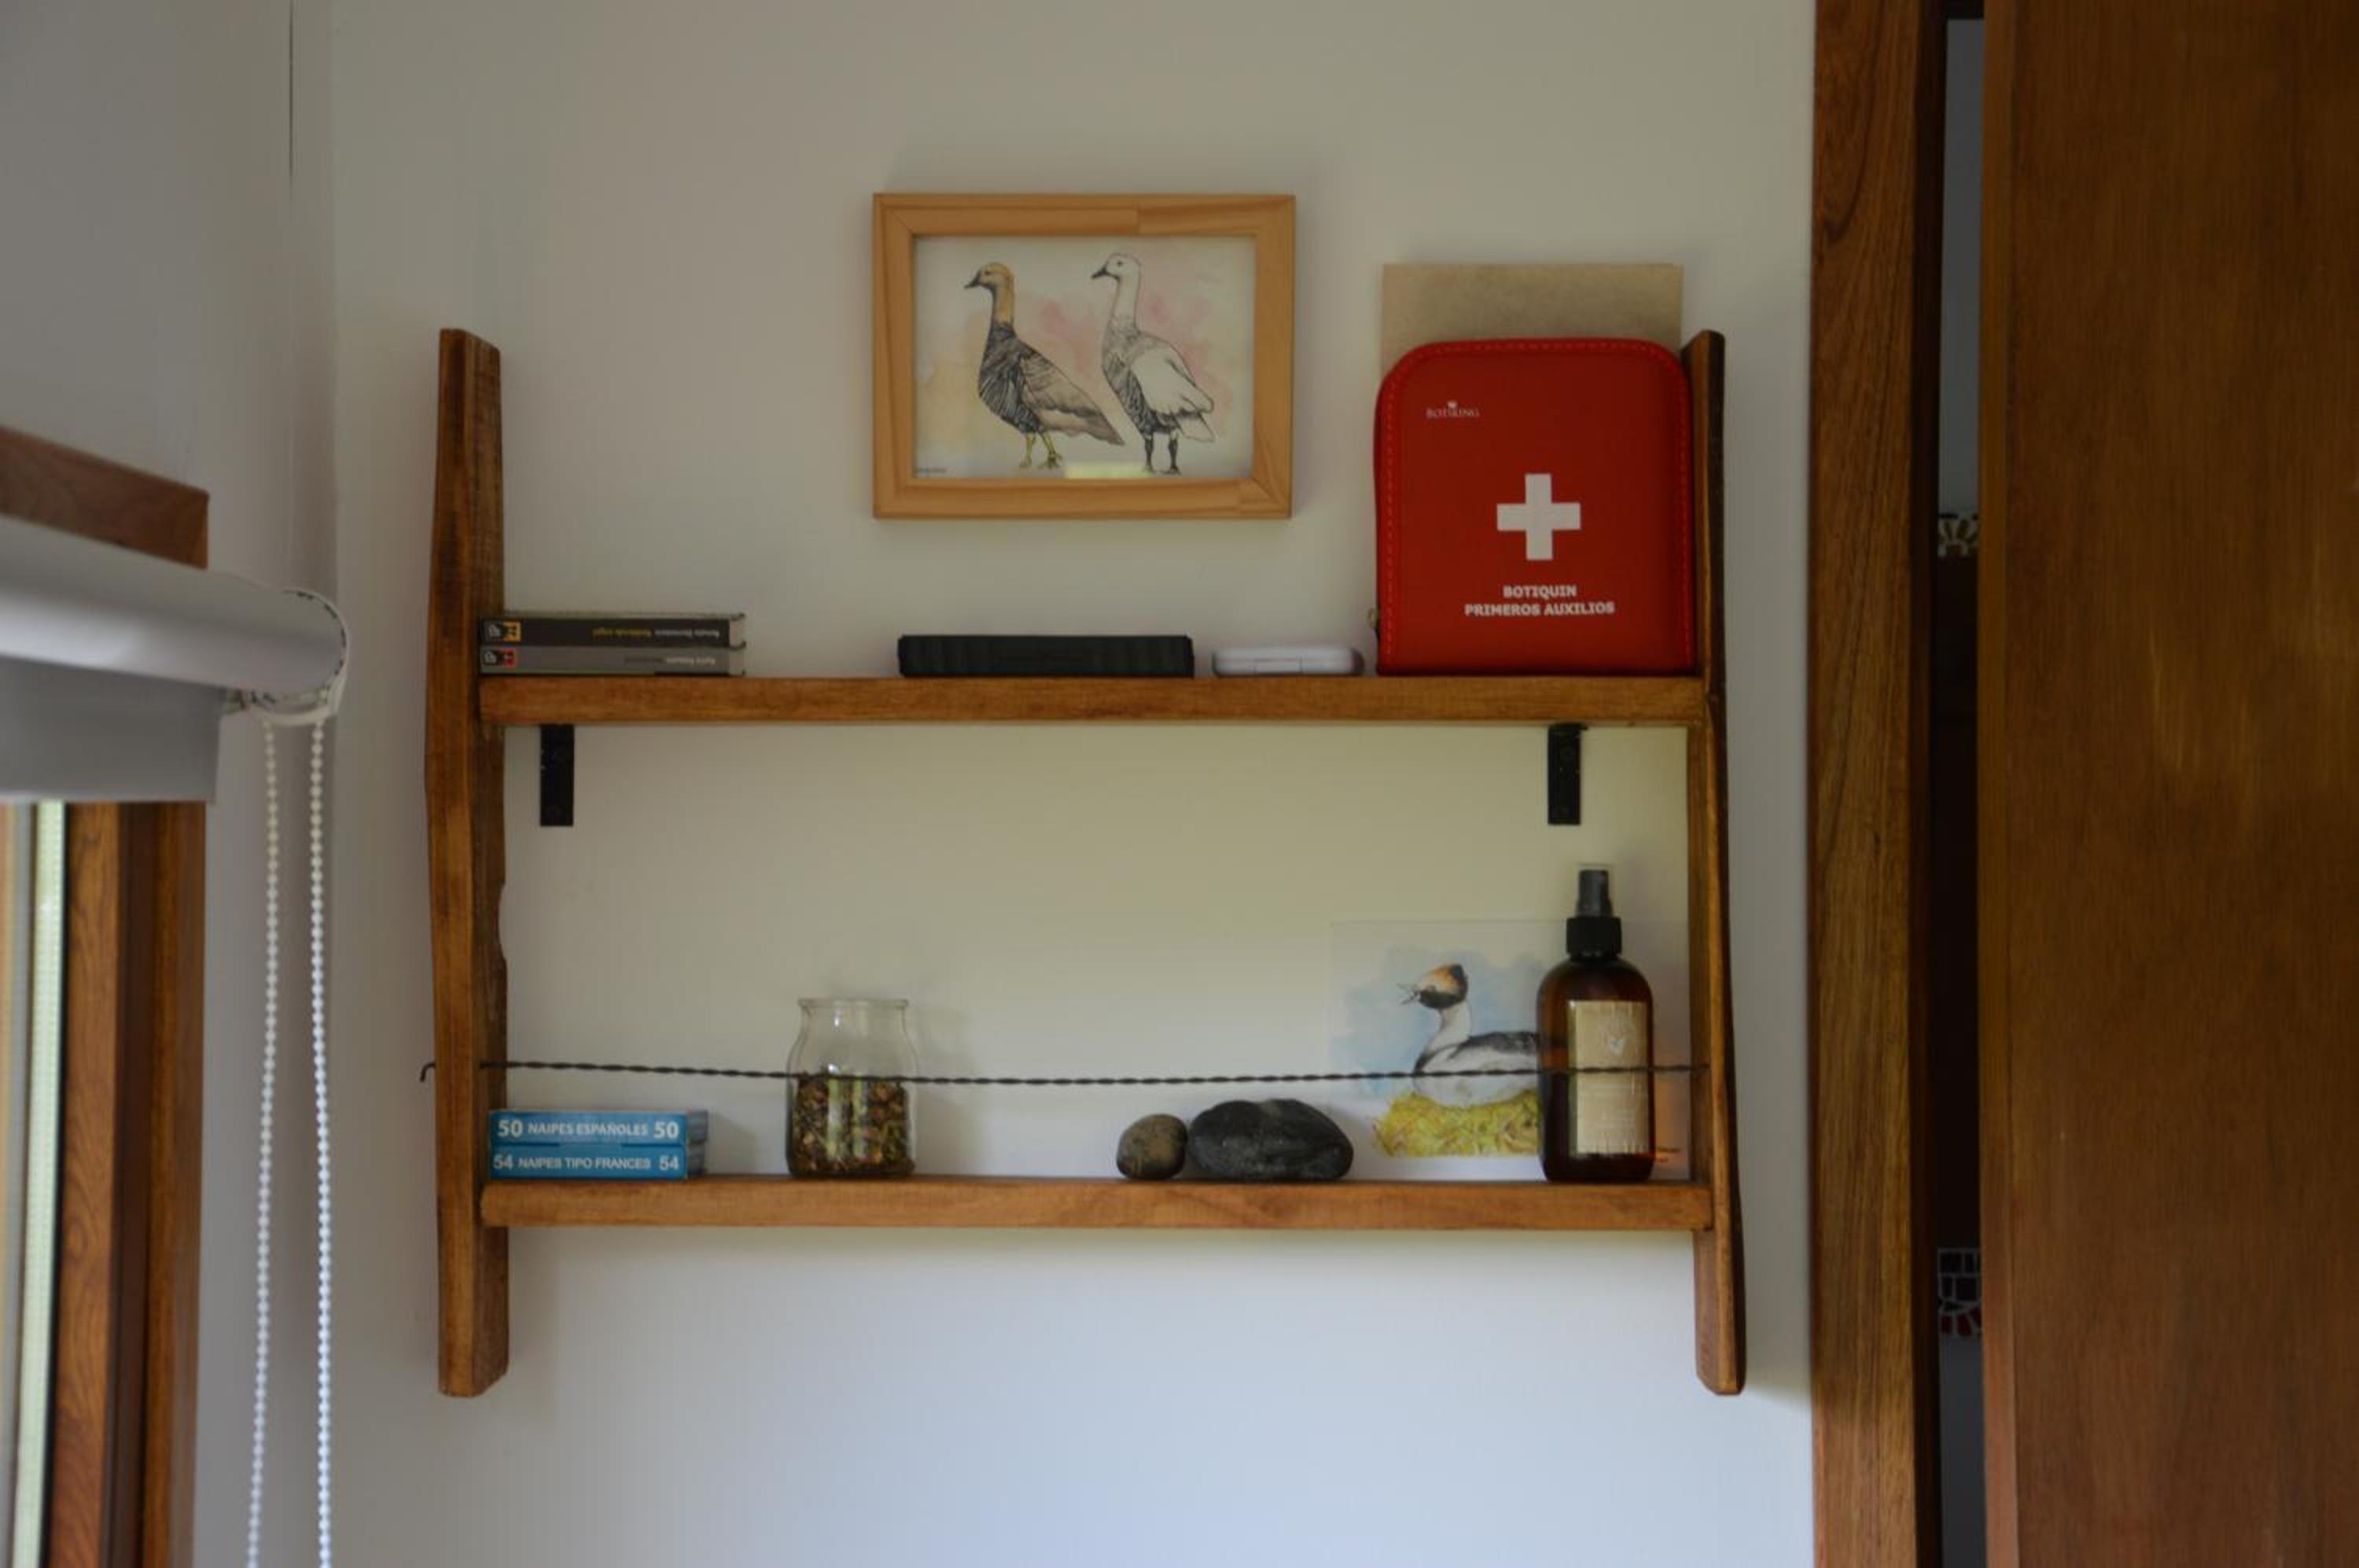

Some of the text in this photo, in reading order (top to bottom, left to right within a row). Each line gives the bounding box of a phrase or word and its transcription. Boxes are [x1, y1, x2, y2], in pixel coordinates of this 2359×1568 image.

[1503, 584, 1577, 601] BOTIQUIN
[1464, 602, 1616, 617] PRIMEROS AUXILIOS
[497, 1119, 679, 1139] 50 NAIPES ESPAÑOLES 50
[493, 1154, 679, 1171] 54 NAIPES TIPO FRANCES 54
